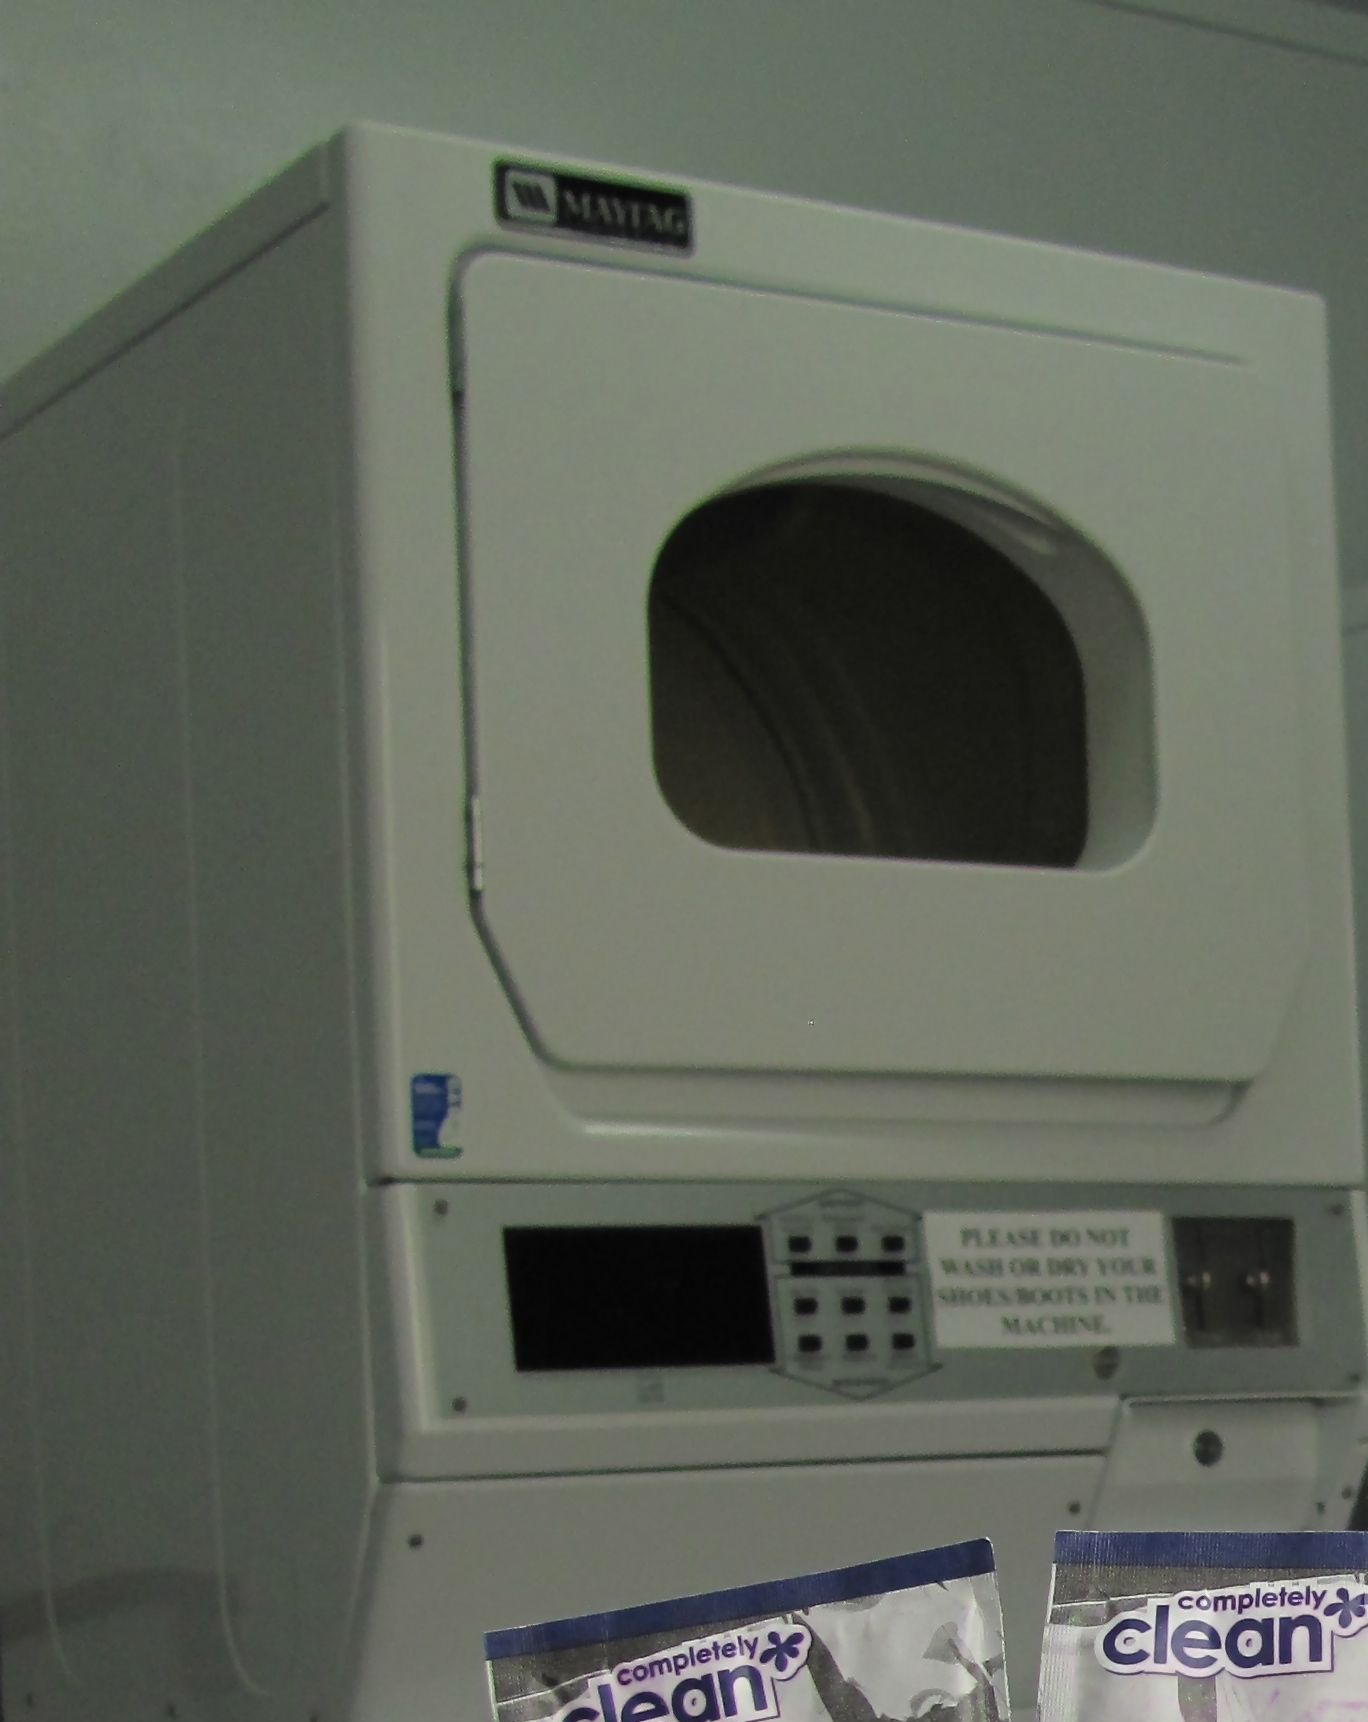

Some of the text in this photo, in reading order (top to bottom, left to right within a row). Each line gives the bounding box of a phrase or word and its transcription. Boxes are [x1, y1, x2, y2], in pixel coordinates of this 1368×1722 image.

[960, 1228, 1130, 1247] PLEASE DO NOT
[939, 1257, 1157, 1277] WASH OR DRY YOUR
[1094, 1286, 1117, 1304] IN
[1122, 1285, 1163, 1304] THE
[1177, 1585, 1328, 1615] completely
[1102, 1604, 1323, 1669] clean
[616, 1635, 759, 1686] completely
